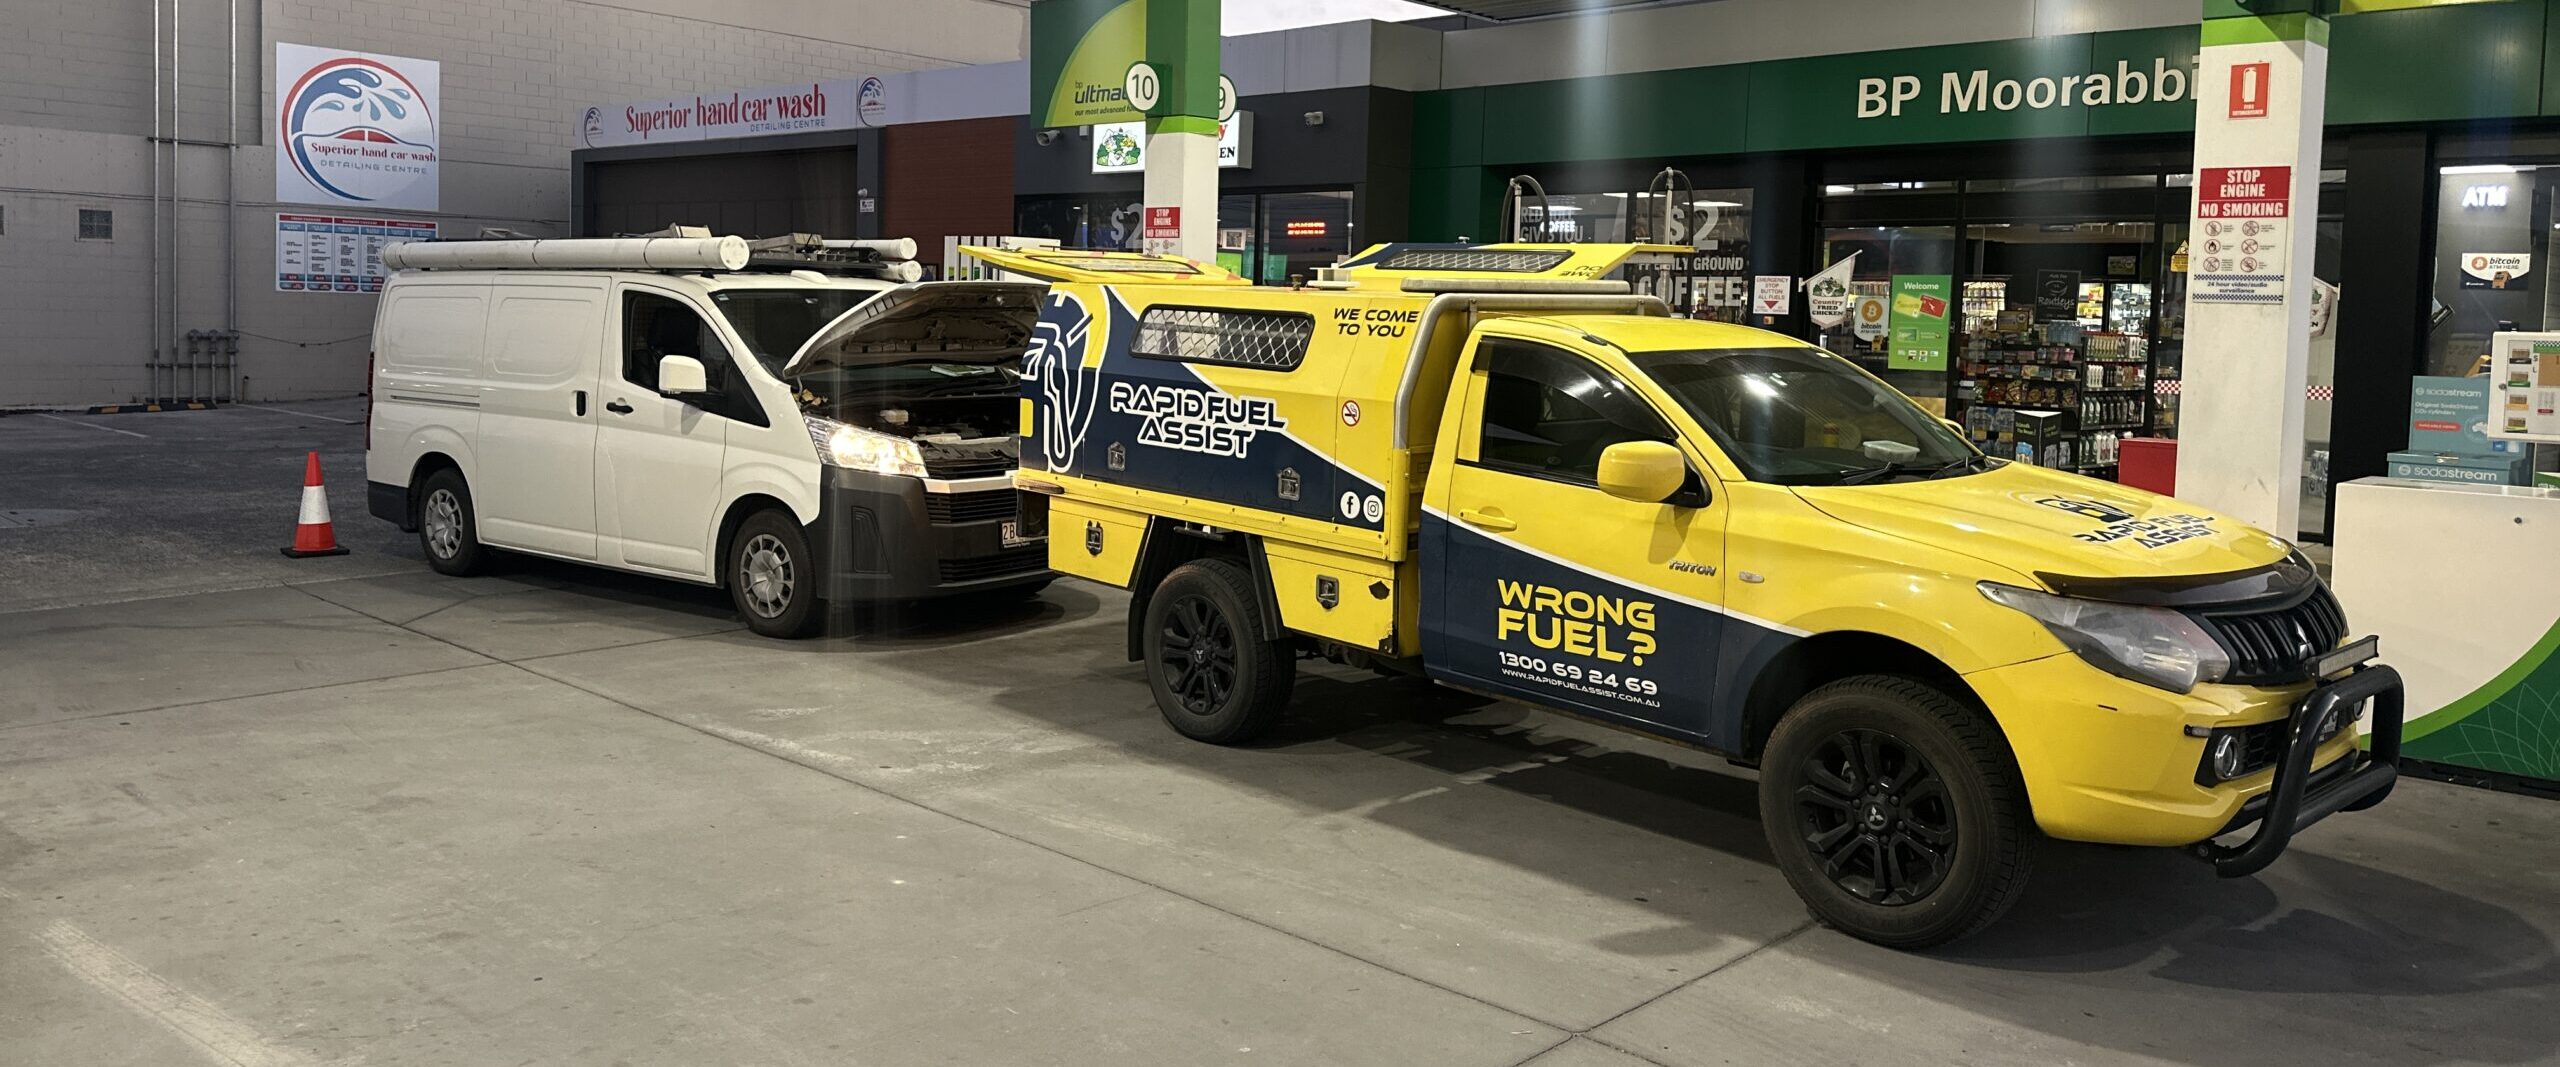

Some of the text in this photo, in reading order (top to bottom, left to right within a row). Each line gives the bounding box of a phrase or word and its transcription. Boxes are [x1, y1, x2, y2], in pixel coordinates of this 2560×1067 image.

[1074, 84, 1128, 104] ultimat
[1131, 73, 1155, 101] 10
[1857, 55, 2199, 118] BP Moorabbi
[625, 83, 826, 140] Superior hand car wash
[1099, 105, 1126, 114] advanced
[750, 118, 826, 133] DETAILING CENTRE
[311, 142, 437, 163] Superior hand car wash
[320, 159, 428, 175] DETAILING CENTRE
[2227, 169, 2261, 184] STOP
[2220, 184, 2266, 198] ENGINE
[2462, 185, 2510, 208] ATM
[1521, 207, 1574, 223] RED ULL
[2200, 202, 2284, 217] NO SMOKING
[1110, 203, 1144, 249] $2
[1521, 226, 1555, 242] GIVS
[1670, 200, 1719, 251] $2
[1693, 257, 1744, 271] GROUND
[2489, 256, 2521, 265] bitcoin
[1638, 276, 1742, 307] COFFEE
[1903, 282, 1940, 290] Welcome
[1812, 298, 1843, 306] Country
[1333, 307, 1420, 323] WE COME
[1337, 322, 1406, 338] TO YOU
[1860, 322, 1882, 330] bitcoin
[2426, 388, 2482, 398] sodastream
[1112, 384, 1287, 431] RAPID FUEL
[1138, 416, 1255, 457] ASSIST
[2413, 465, 2498, 482] sodastream
[2072, 513, 2215, 542] RAPID FUEL
[2133, 524, 2221, 549] ASSIST
[1669, 560, 1718, 577] TRITON
[1497, 578, 1656, 632] WRONG
[1497, 607, 1657, 668] FUEL?
[1498, 651, 1658, 696] 1300 69 24 69
[1501, 668, 1661, 708] WWW.RAPIDFUELASSIST.COM.AU
